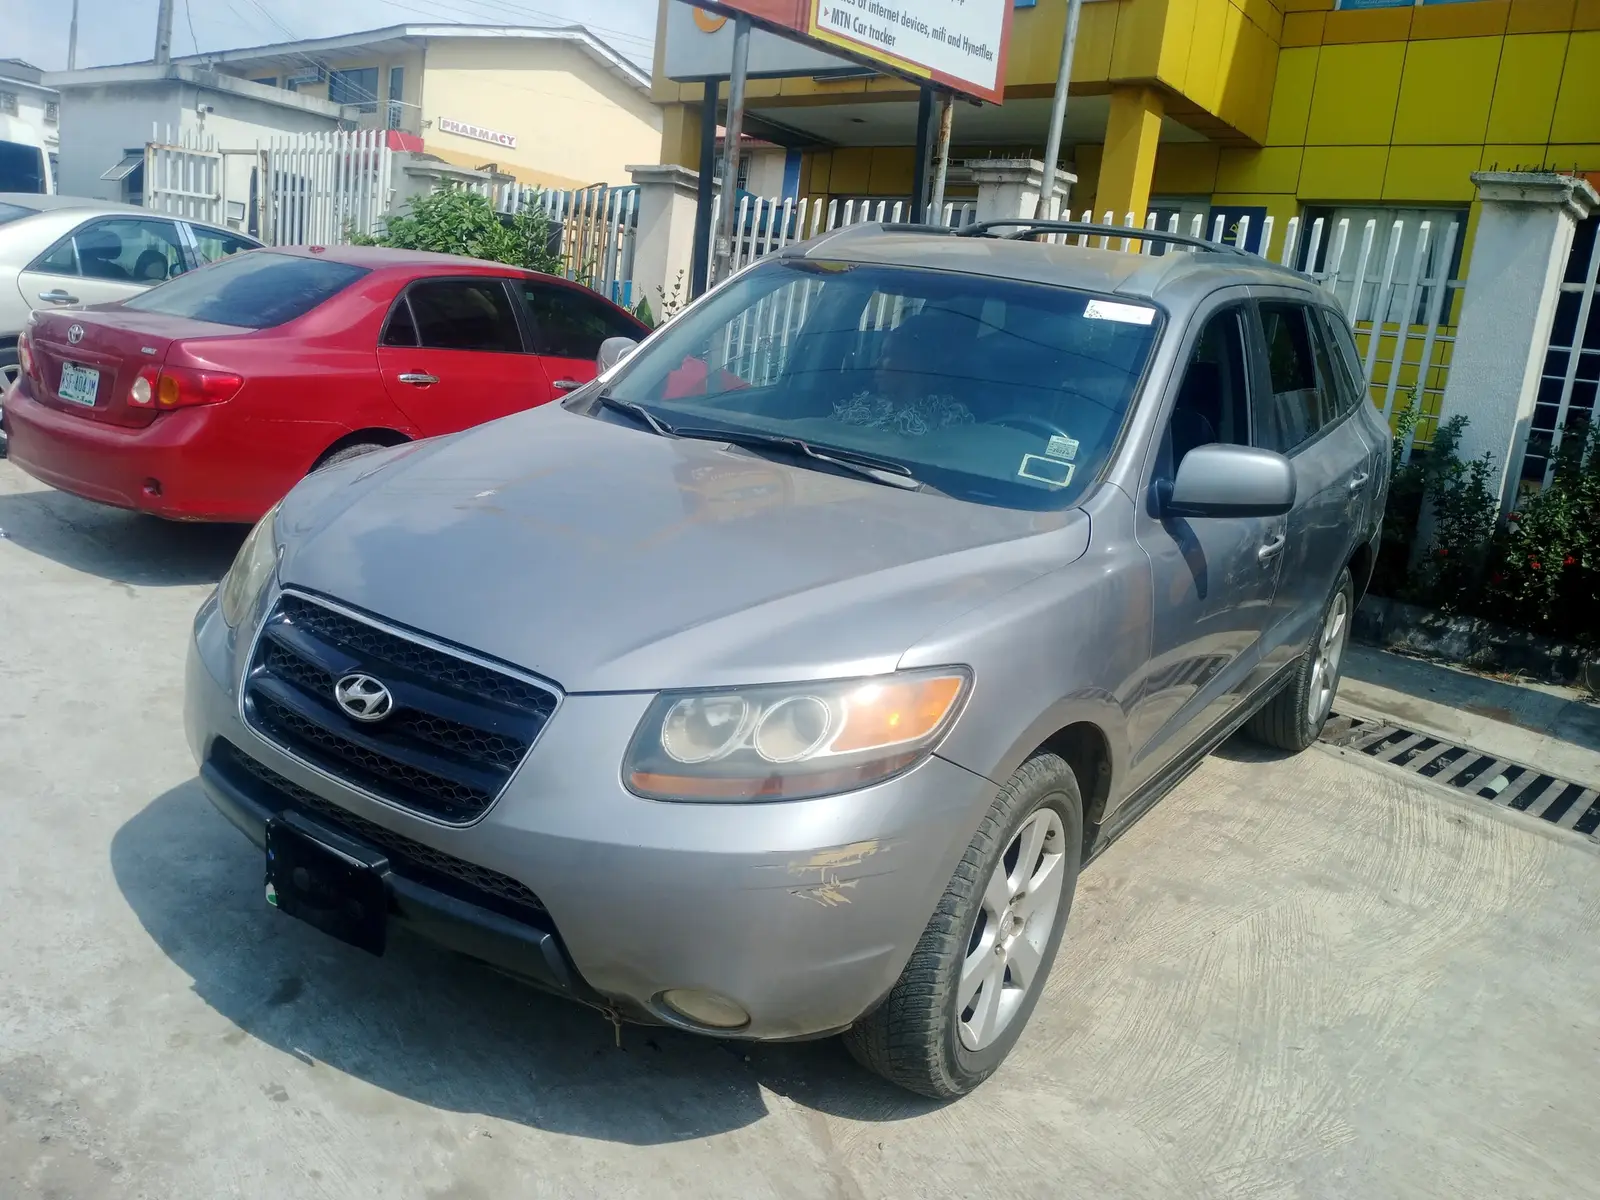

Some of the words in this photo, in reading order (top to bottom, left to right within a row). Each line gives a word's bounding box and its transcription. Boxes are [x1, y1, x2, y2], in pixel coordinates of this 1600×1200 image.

[831, 7, 851, 29] MTN
[853, 17, 867, 36] Car
[869, 24, 896, 46] tracker
[868, 1, 900, 23] internet
[901, 10, 930, 38] devices,
[931, 26, 947, 42] mifi
[947, 33, 961, 48] and
[962, 35, 993, 61] Hynetflex
[442, 120, 515, 145] PHARMACY
